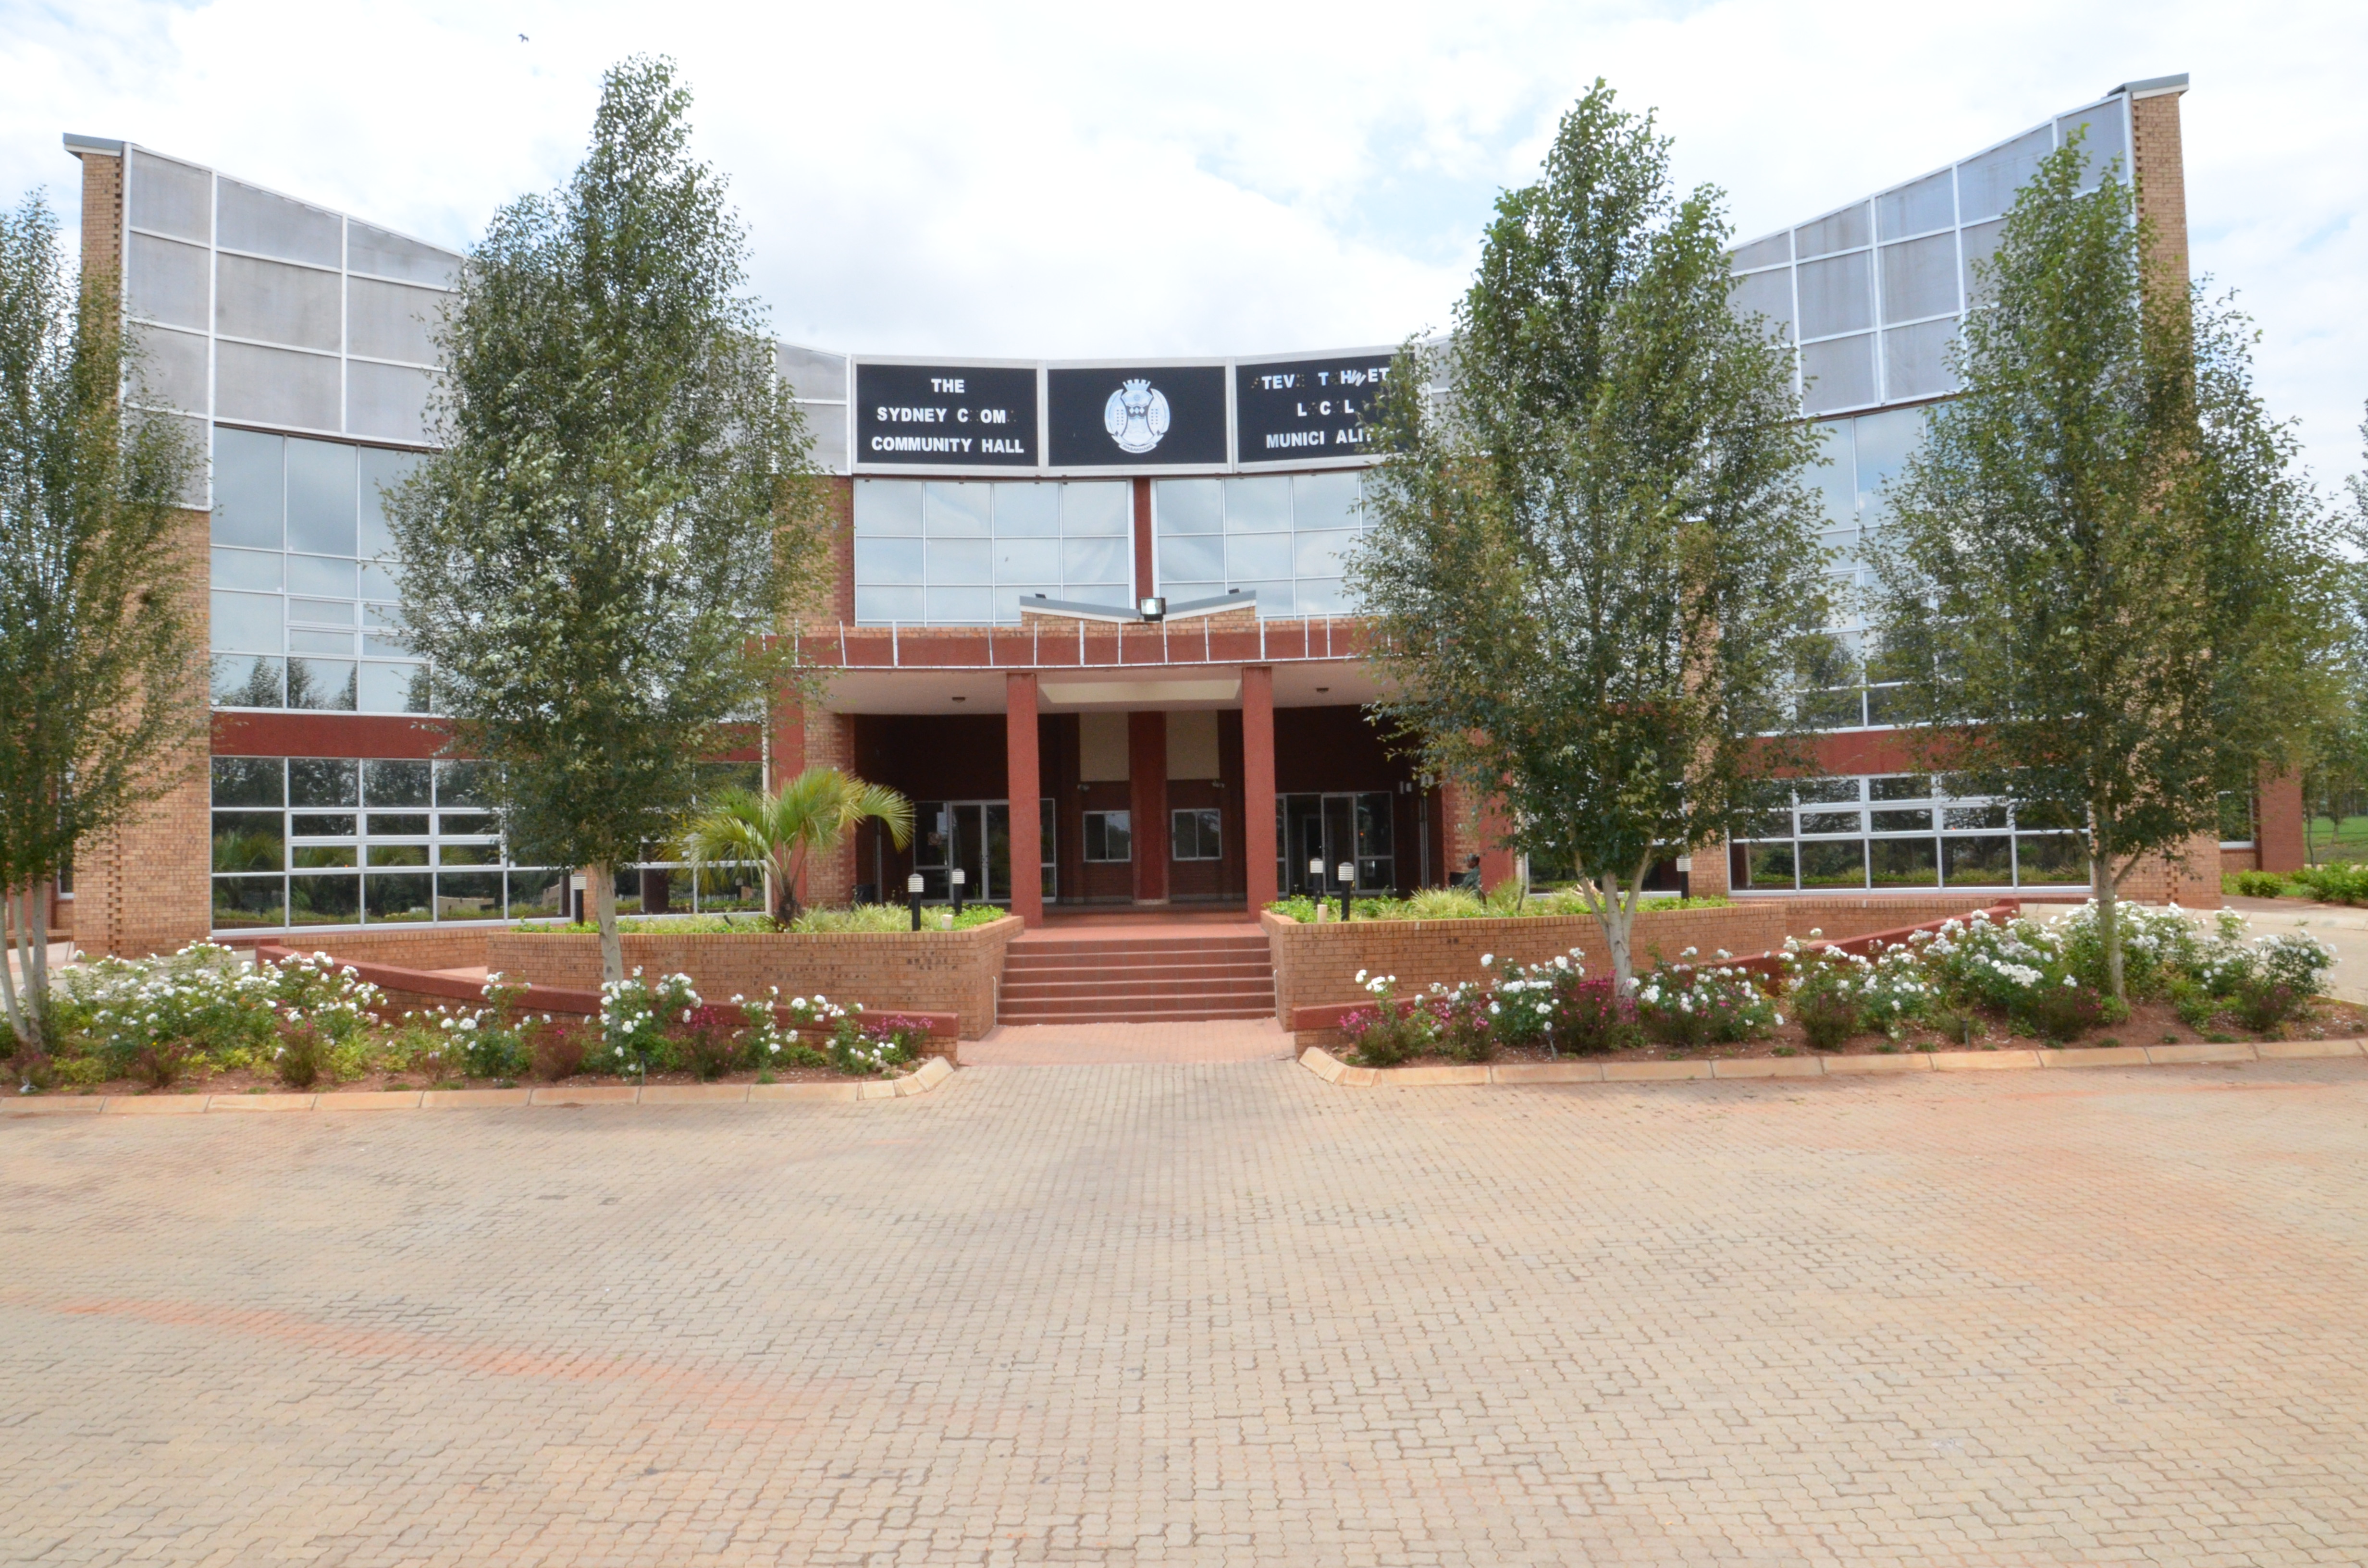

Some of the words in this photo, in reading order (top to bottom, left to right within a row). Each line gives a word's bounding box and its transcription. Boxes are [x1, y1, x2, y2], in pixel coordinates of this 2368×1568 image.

[931, 379, 965, 393] THE
[876, 407, 947, 422] SYDNEY
[871, 436, 972, 452] COMMUNITY
[982, 439, 1024, 453] HALL
